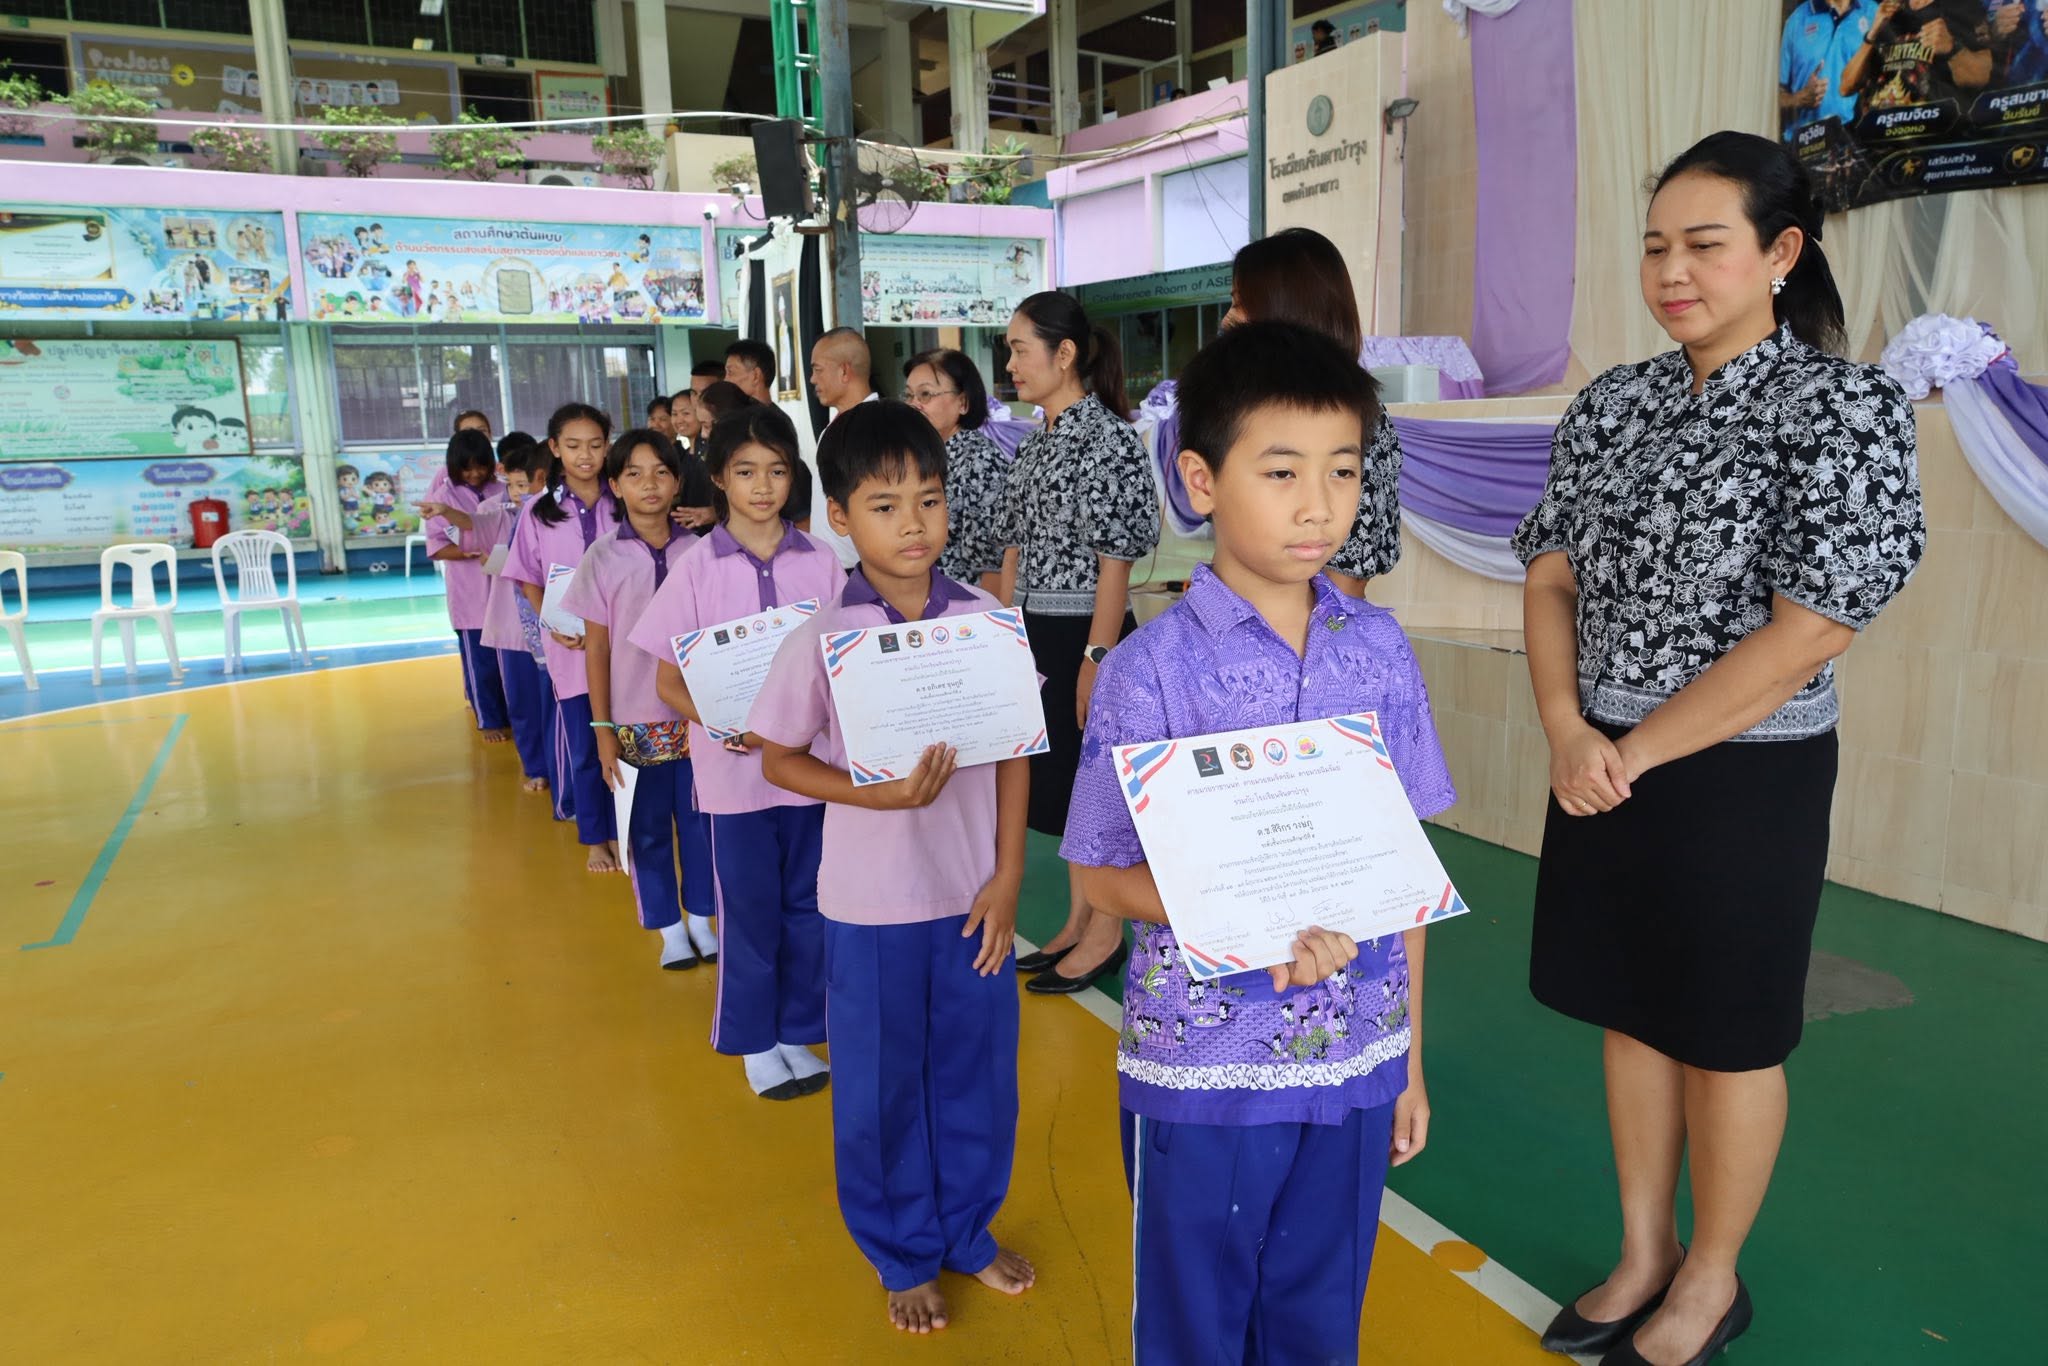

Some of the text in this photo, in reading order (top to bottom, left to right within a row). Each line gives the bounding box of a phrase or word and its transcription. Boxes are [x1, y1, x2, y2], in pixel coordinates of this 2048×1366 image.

[1989, 88, 2048, 111] ครูสมชา
[1876, 107, 1940, 128] ครูสมจิตร
[1269, 139, 1368, 180] โรงเรียนจินดาบำรุง
[453, 226, 562, 244] สถานศึกษาต้นแบบ
[1092, 275, 1233, 304] Conference Room of ASE
